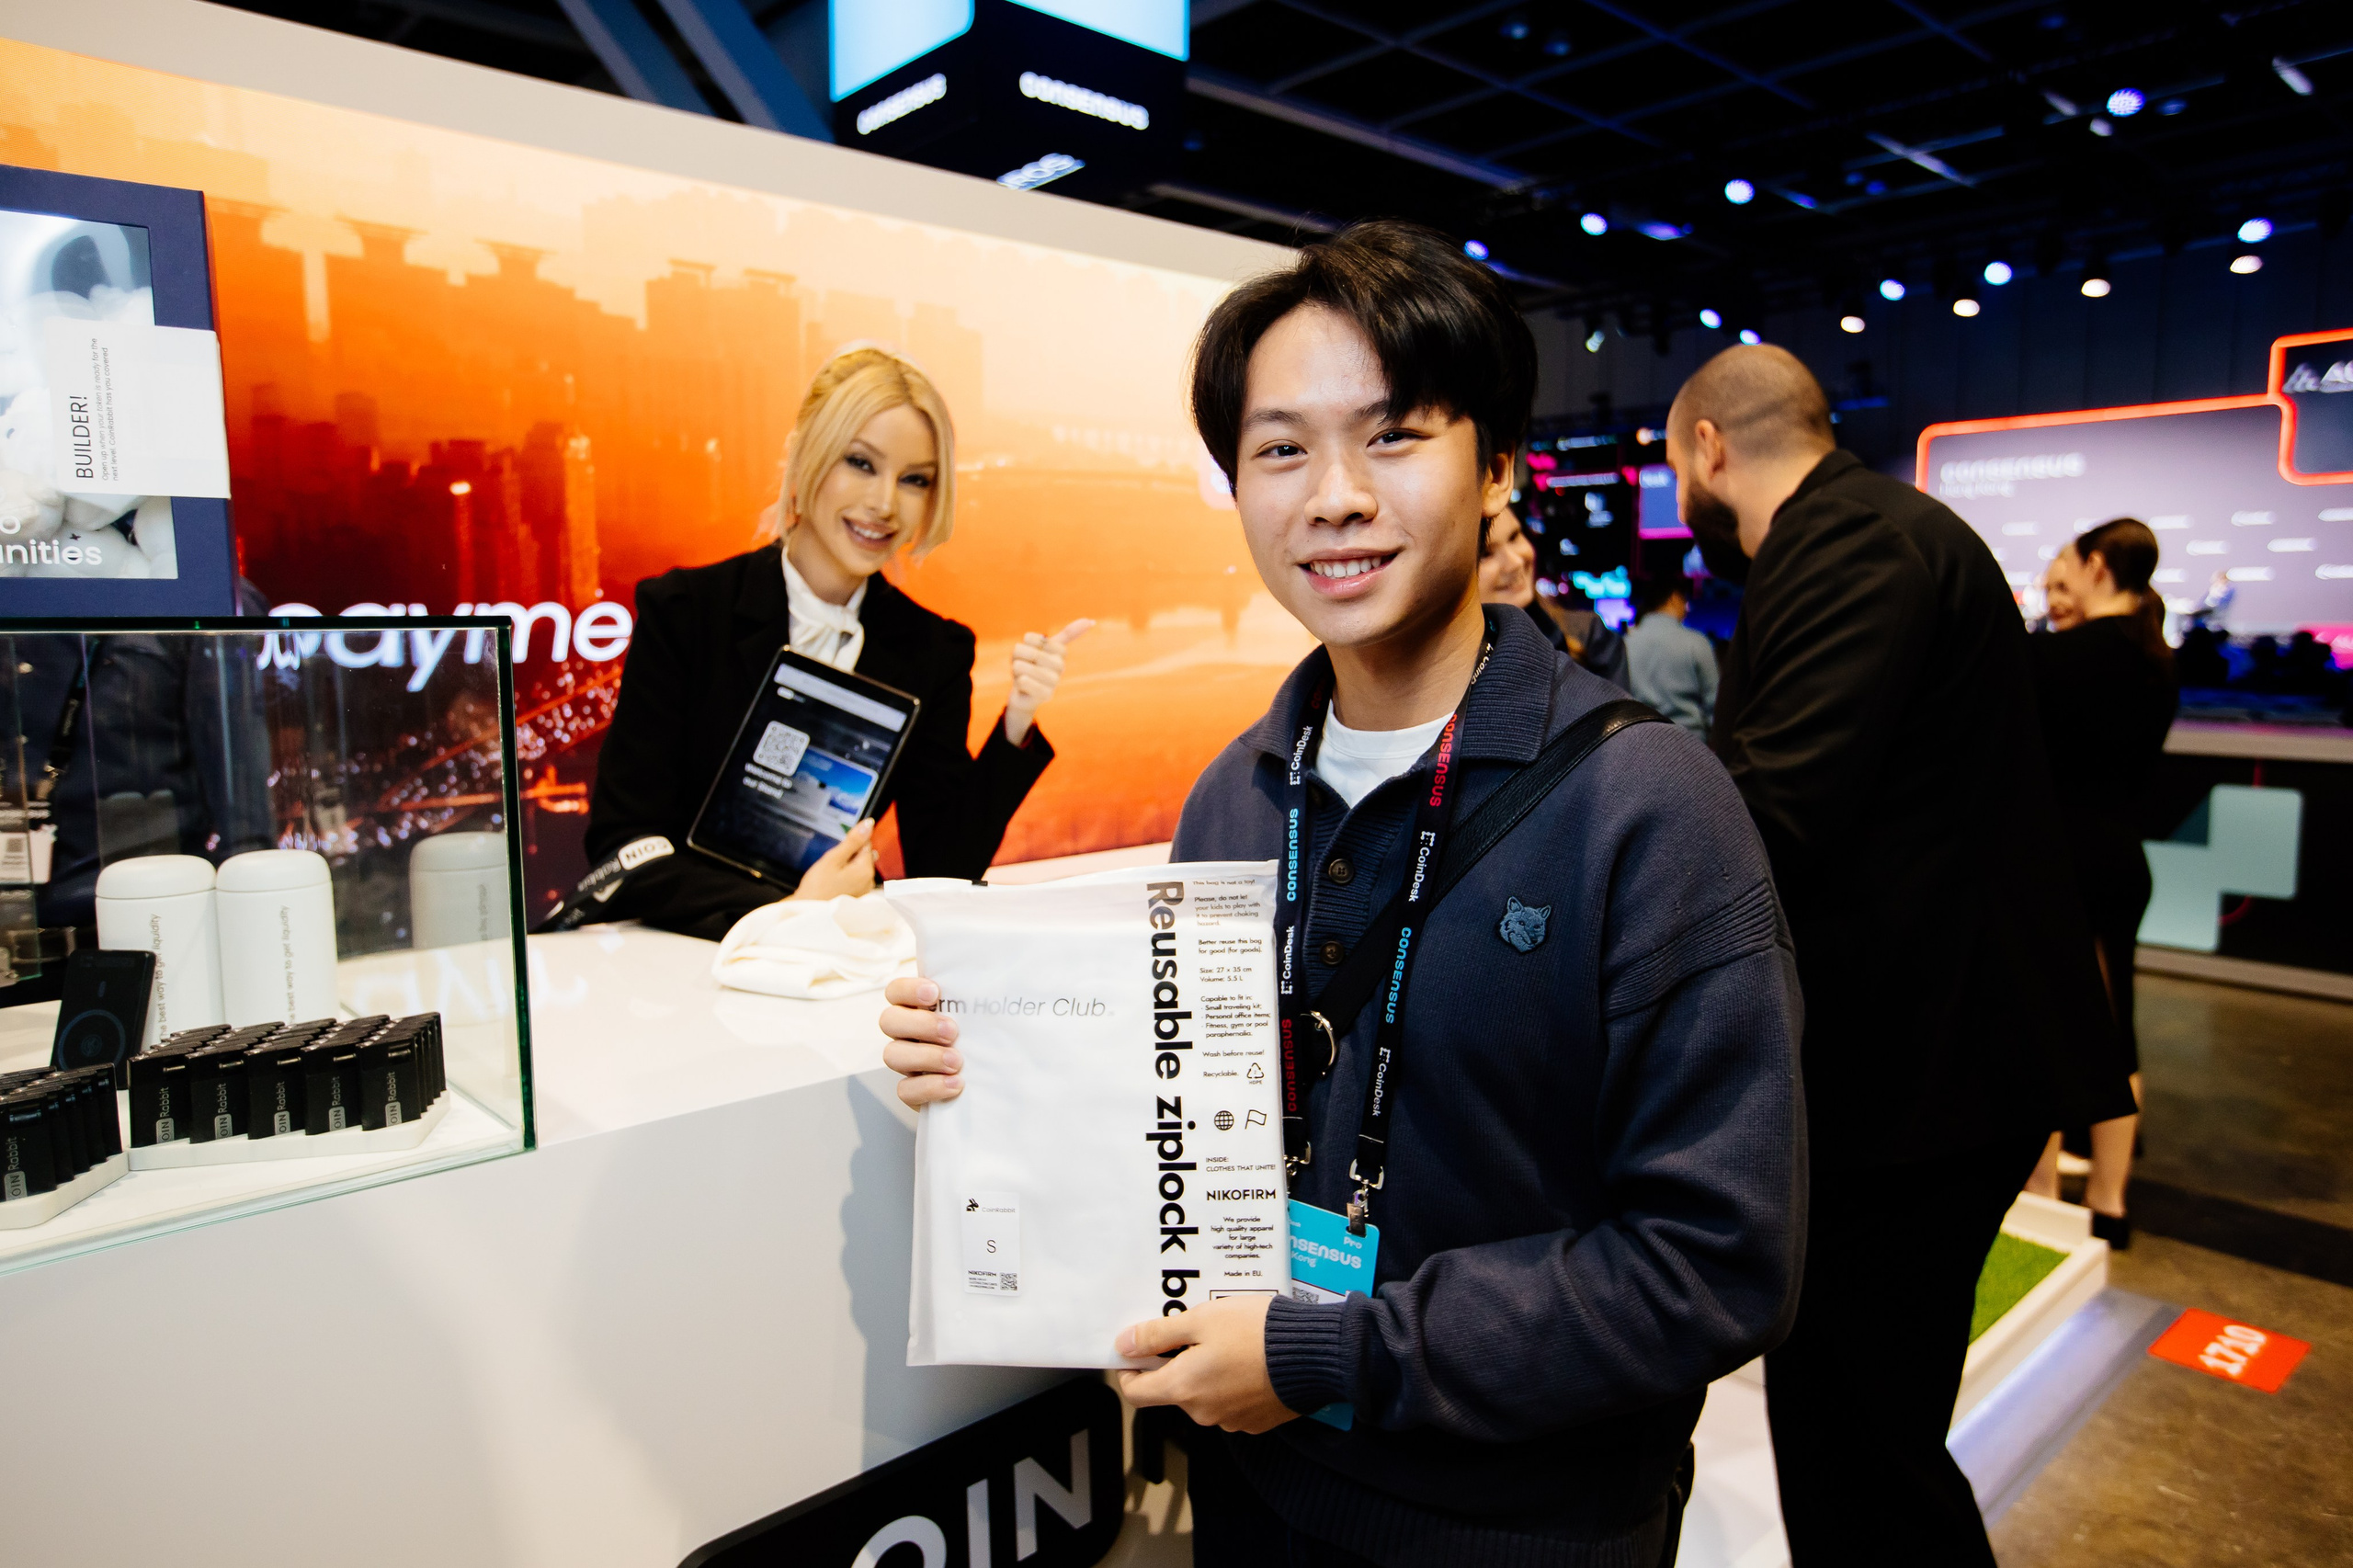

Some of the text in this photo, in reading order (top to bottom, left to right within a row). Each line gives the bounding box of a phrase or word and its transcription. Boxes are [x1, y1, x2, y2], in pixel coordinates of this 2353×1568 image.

[93, 362, 101, 383] ready
[102, 347, 110, 377] covered
[97, 413, 107, 428] your
[107, 406, 116, 446] CoinRabbit
[70, 396, 94, 478] BUILDER!
[101, 450, 108, 460] up
[102, 461, 110, 481] Open
[1290, 725, 1313, 771] CoinDesk
[1408, 846, 1430, 903] CoinDesk
[1210, 947, 1225, 955] good
[1282, 925, 1294, 980] CoinDesk
[1146, 881, 1193, 1080] Reusable
[972, 996, 1046, 1017] Holder
[388, 1072, 396, 1102] Rabbit
[1203, 1070, 1239, 1078] Recyclable.
[160, 1086, 169, 1118] Rabbit
[218, 1083, 227, 1114] Rabbit
[277, 1081, 287, 1111] Rabbit
[332, 1076, 340, 1106] Rabbit
[1372, 1062, 1387, 1117] CoinDesk
[8, 1136, 17, 1172] Rabbit
[1145, 1096, 1199, 1254] ziplock
[1206, 1188, 1277, 1201] NIKOFIRM
[1249, 1224, 1274, 1233] apparel
[1343, 1237, 1362, 1249] Pro
[986, 1239, 996, 1254] S
